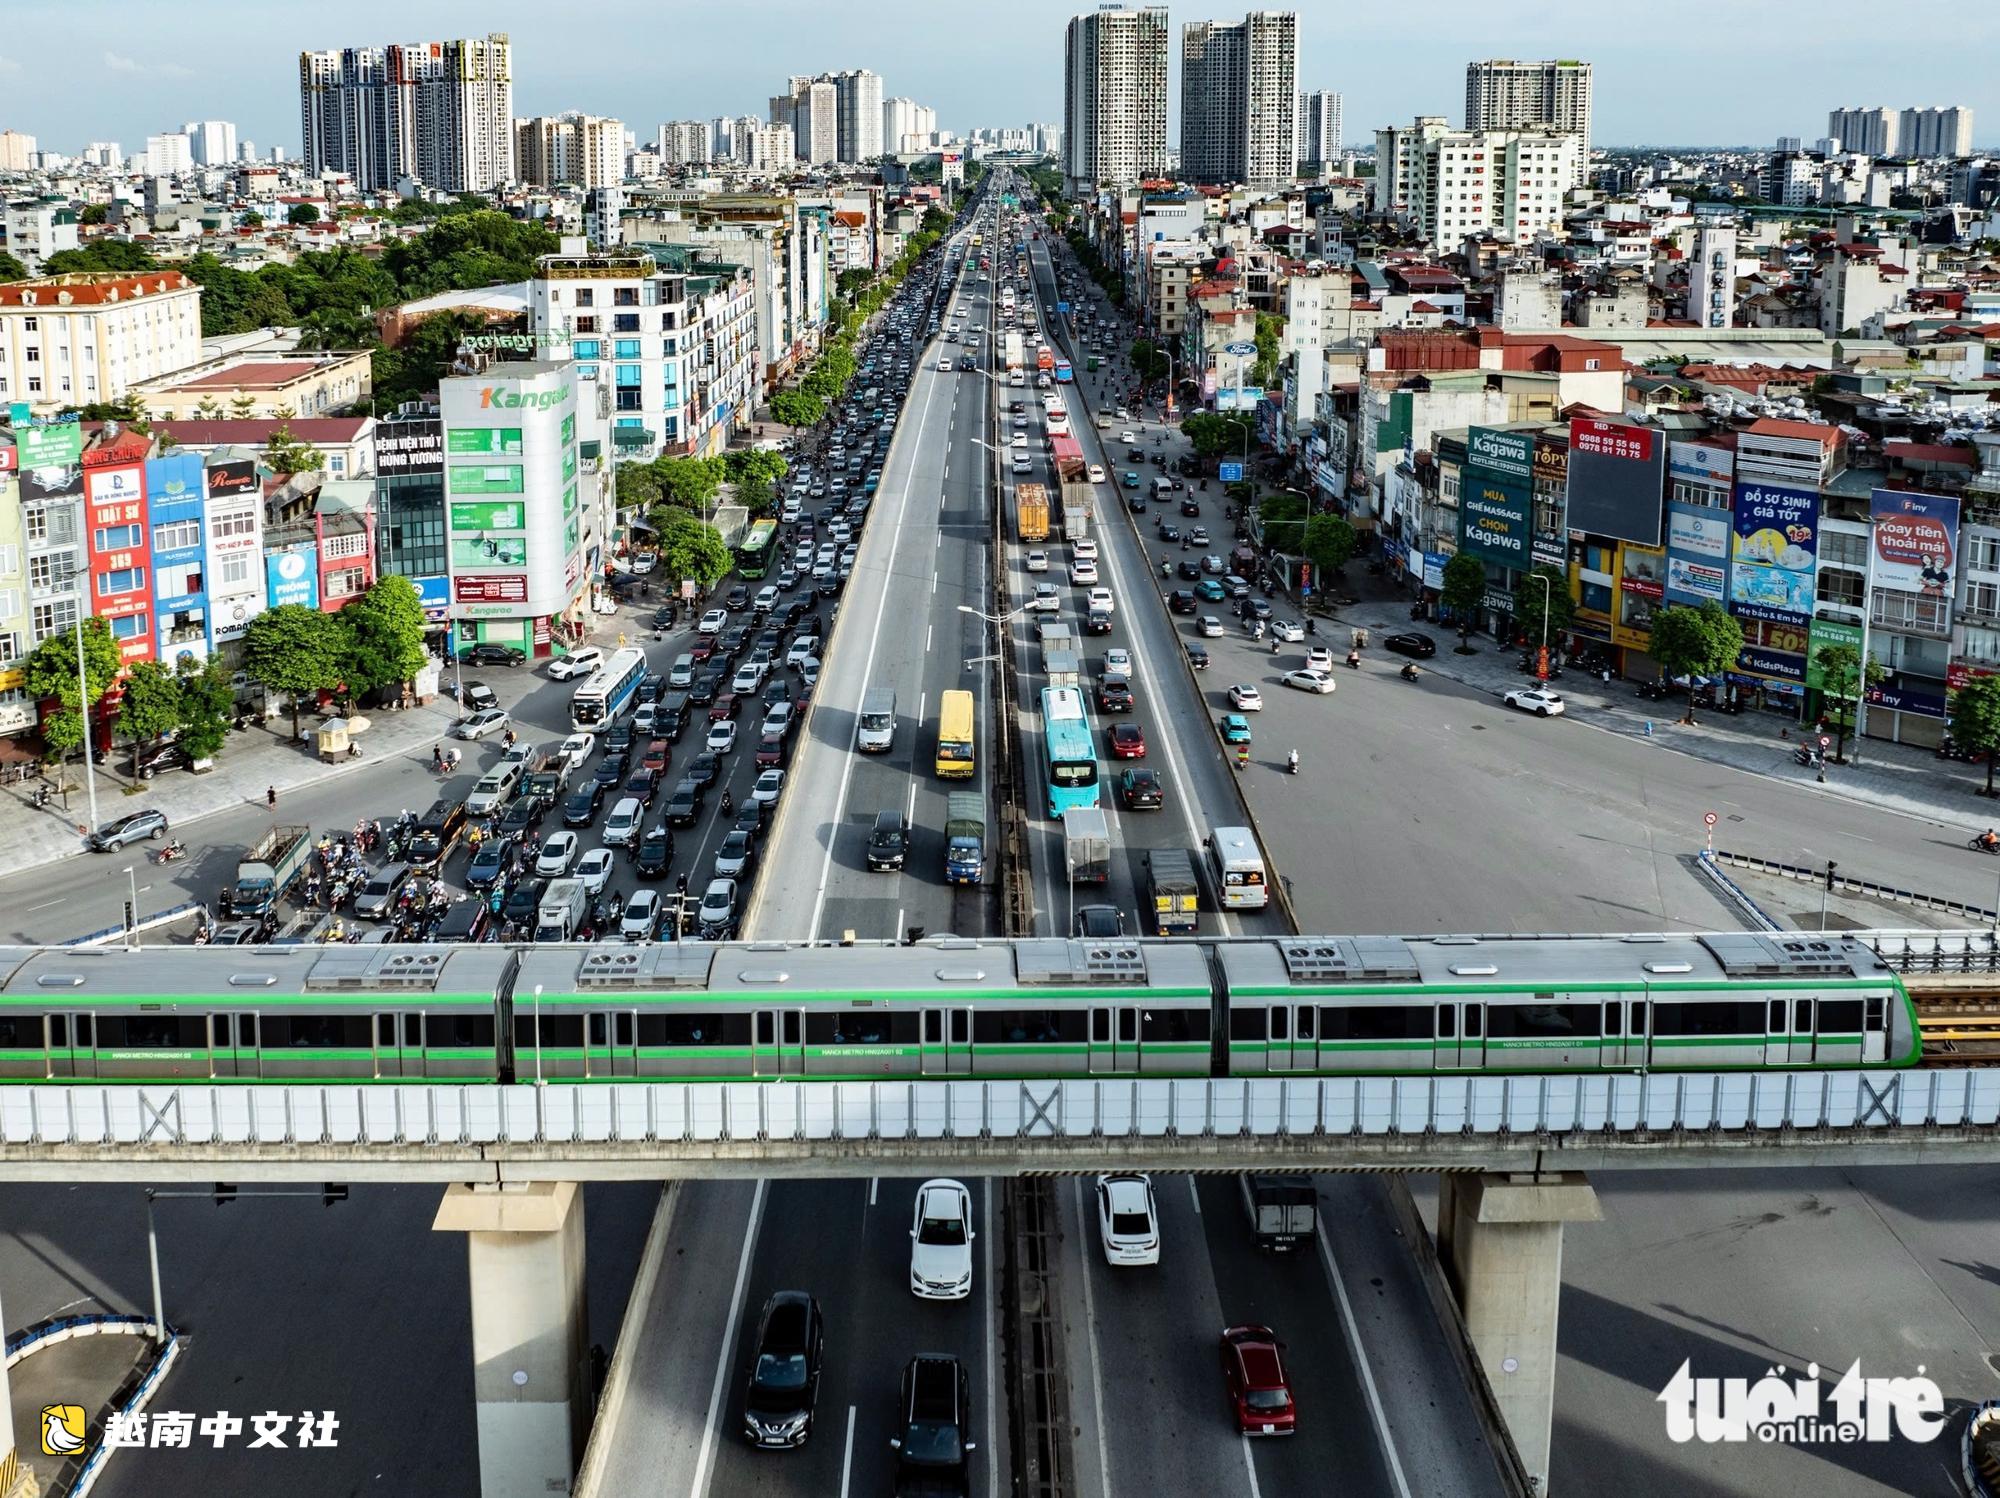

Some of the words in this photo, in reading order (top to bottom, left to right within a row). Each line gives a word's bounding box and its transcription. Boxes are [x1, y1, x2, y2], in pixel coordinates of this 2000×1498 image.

[1230, 344, 1251, 354] Ford
[376, 438, 397, 452] BỆNH
[398, 436, 418, 452] VIỆN
[419, 434, 435, 448] THÚ
[435, 436, 441, 447] Y
[1473, 436, 1525, 460] Kagawa
[1496, 435, 1526, 448] MASSAGE
[1579, 433, 1600, 444] 0988
[1602, 436, 1614, 445] 59
[1616, 439, 1627, 448] 55
[1629, 441, 1641, 450] 66
[1578, 442, 1600, 452] 0978
[1602, 445, 1612, 454] 91
[1616, 447, 1627, 456] 70
[1629, 450, 1640, 458] 75
[379, 452, 407, 467] HÙNG
[409, 451, 443, 465] VƯƠNG
[1483, 488, 1505, 502] MUA
[1744, 487, 1762, 502] ĐỒ
[1764, 493, 1780, 504] SƠ
[1782, 496, 1811, 509] SINH
[96, 505, 121, 525] LUẬT
[125, 502, 140, 519] SƯ
[1483, 505, 1522, 521] MASSAGE
[1777, 507, 1801, 521] TỐT
[1479, 517, 1508, 533] CHỌN
[1878, 522, 1912, 537] Xoay
[1915, 525, 1942, 538] tiền
[1466, 524, 1521, 550] Kagawa
[1881, 535, 1917, 549] thoải
[1920, 541, 1945, 553] mái
[1533, 540, 1564, 553] caesar
[464, 605, 513, 616] Kangaroo
[1480, 595, 1514, 611] gawa
[1737, 607, 1751, 616] Mẹ
[1777, 613, 1791, 622] Em
[215, 622, 253, 635] ROMANT
[1753, 659, 1800, 675] KidsPlaza
[1872, 691, 1901, 706] Finy
